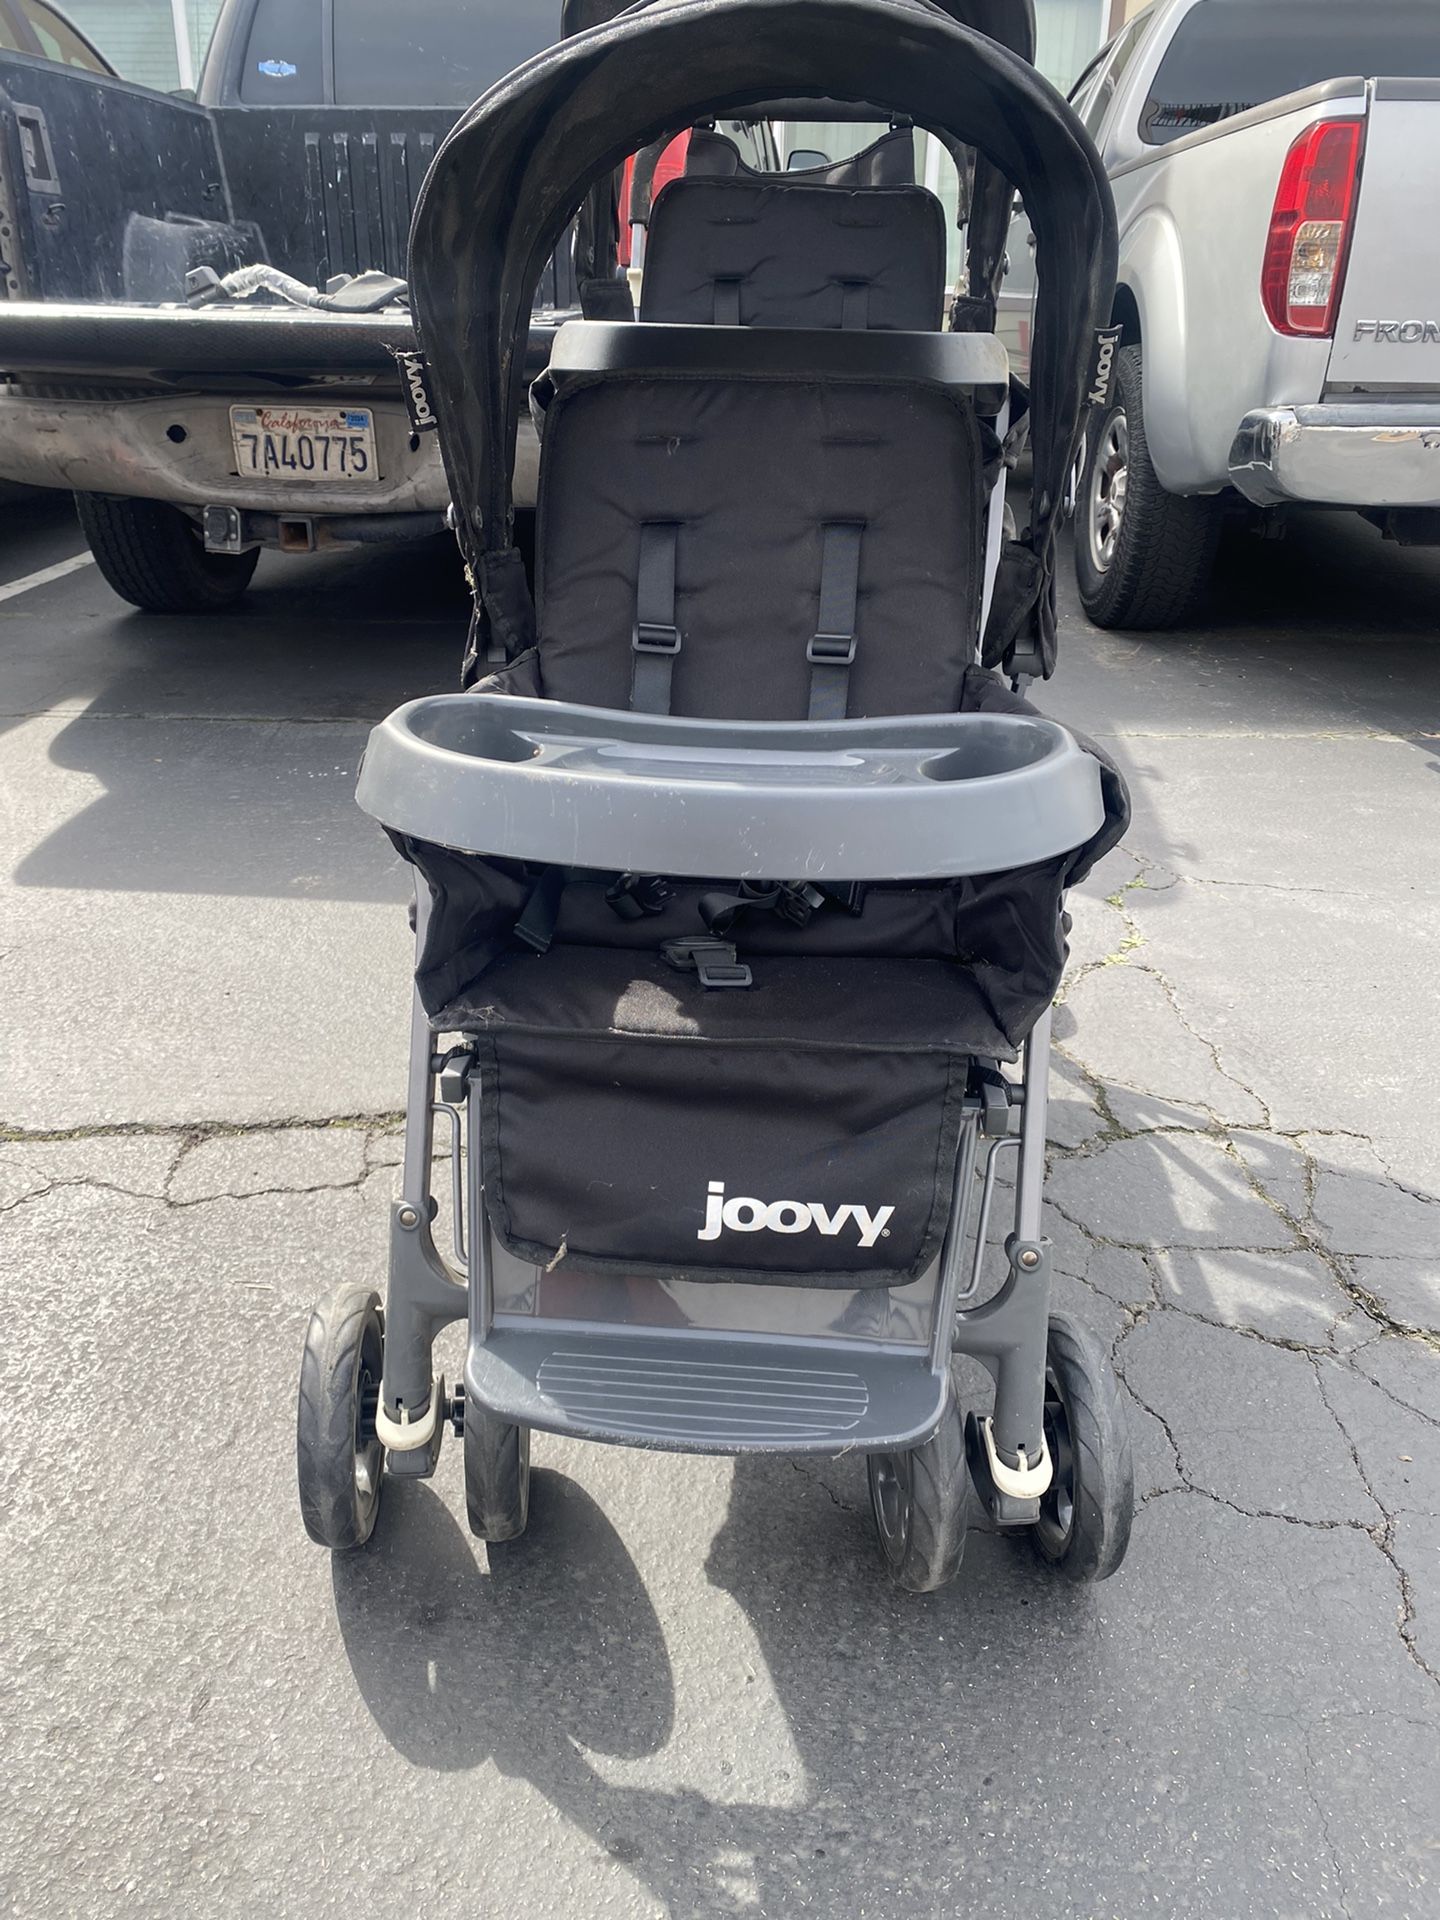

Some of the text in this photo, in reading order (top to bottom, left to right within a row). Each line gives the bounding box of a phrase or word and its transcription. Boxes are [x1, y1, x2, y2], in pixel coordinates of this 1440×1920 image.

[1353, 319, 1440, 343] FRON
[1088, 334, 1119, 405] joovy
[404, 358, 438, 426] joovy
[260, 411, 342, 434] California
[242, 433, 368, 472] 7A40775
